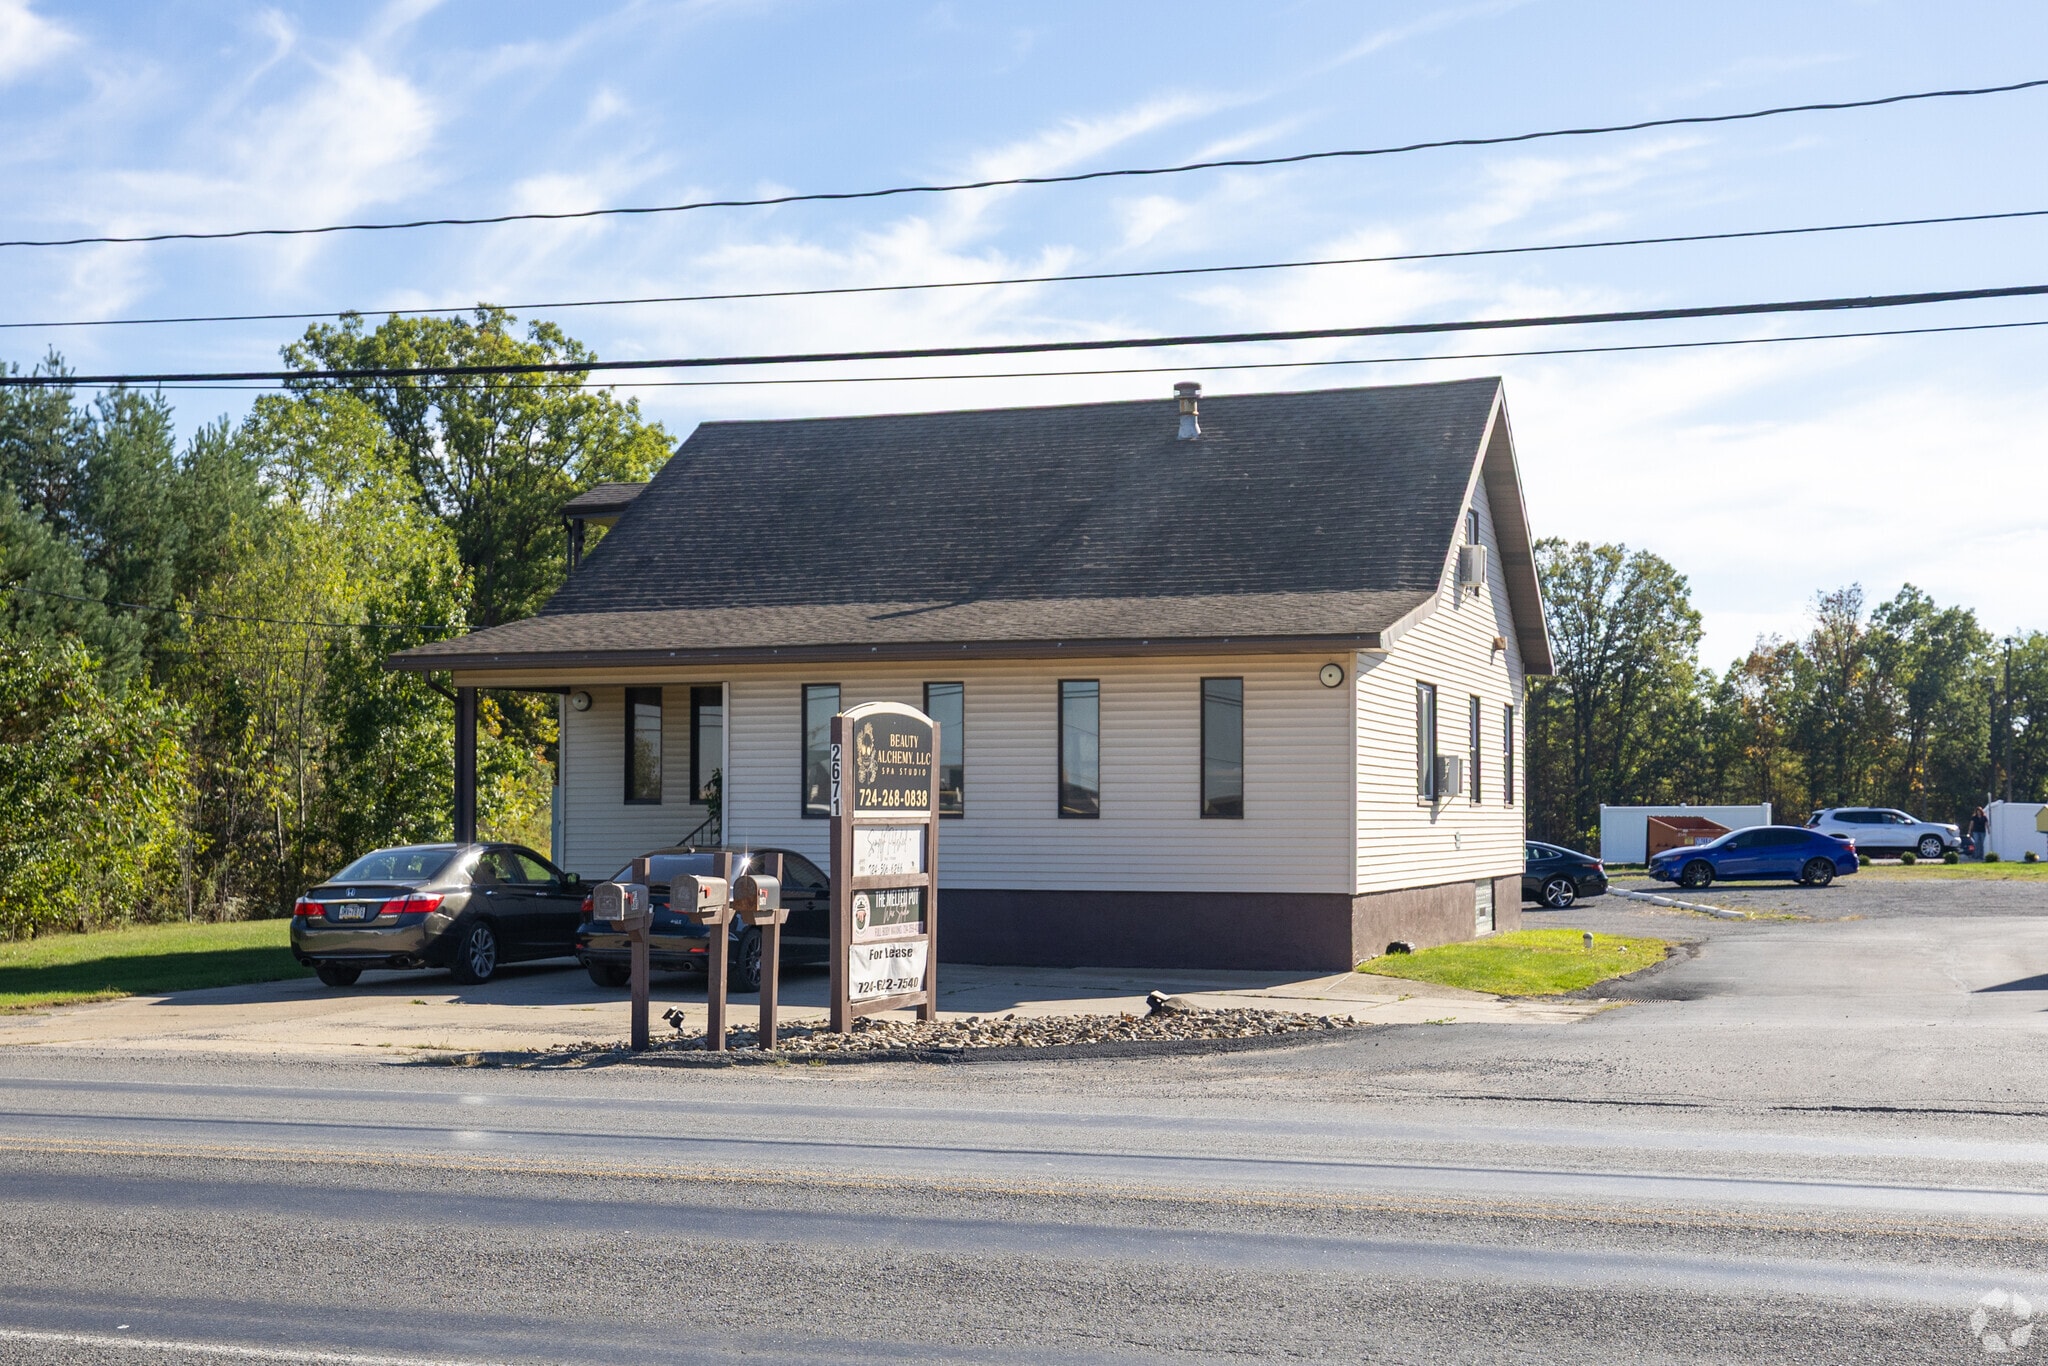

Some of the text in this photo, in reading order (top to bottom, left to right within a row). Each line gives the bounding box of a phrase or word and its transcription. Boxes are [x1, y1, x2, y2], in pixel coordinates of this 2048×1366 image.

[890, 734, 919, 748] BEAUTY
[916, 751, 931, 766] LLC
[881, 767, 926, 776] SPA STUDIO
[831, 745, 840, 816] 2671
[860, 788, 928, 806] 724-268-0838
[875, 888, 920, 908] THE MELTED POT
[869, 947, 913, 960] For Lease
